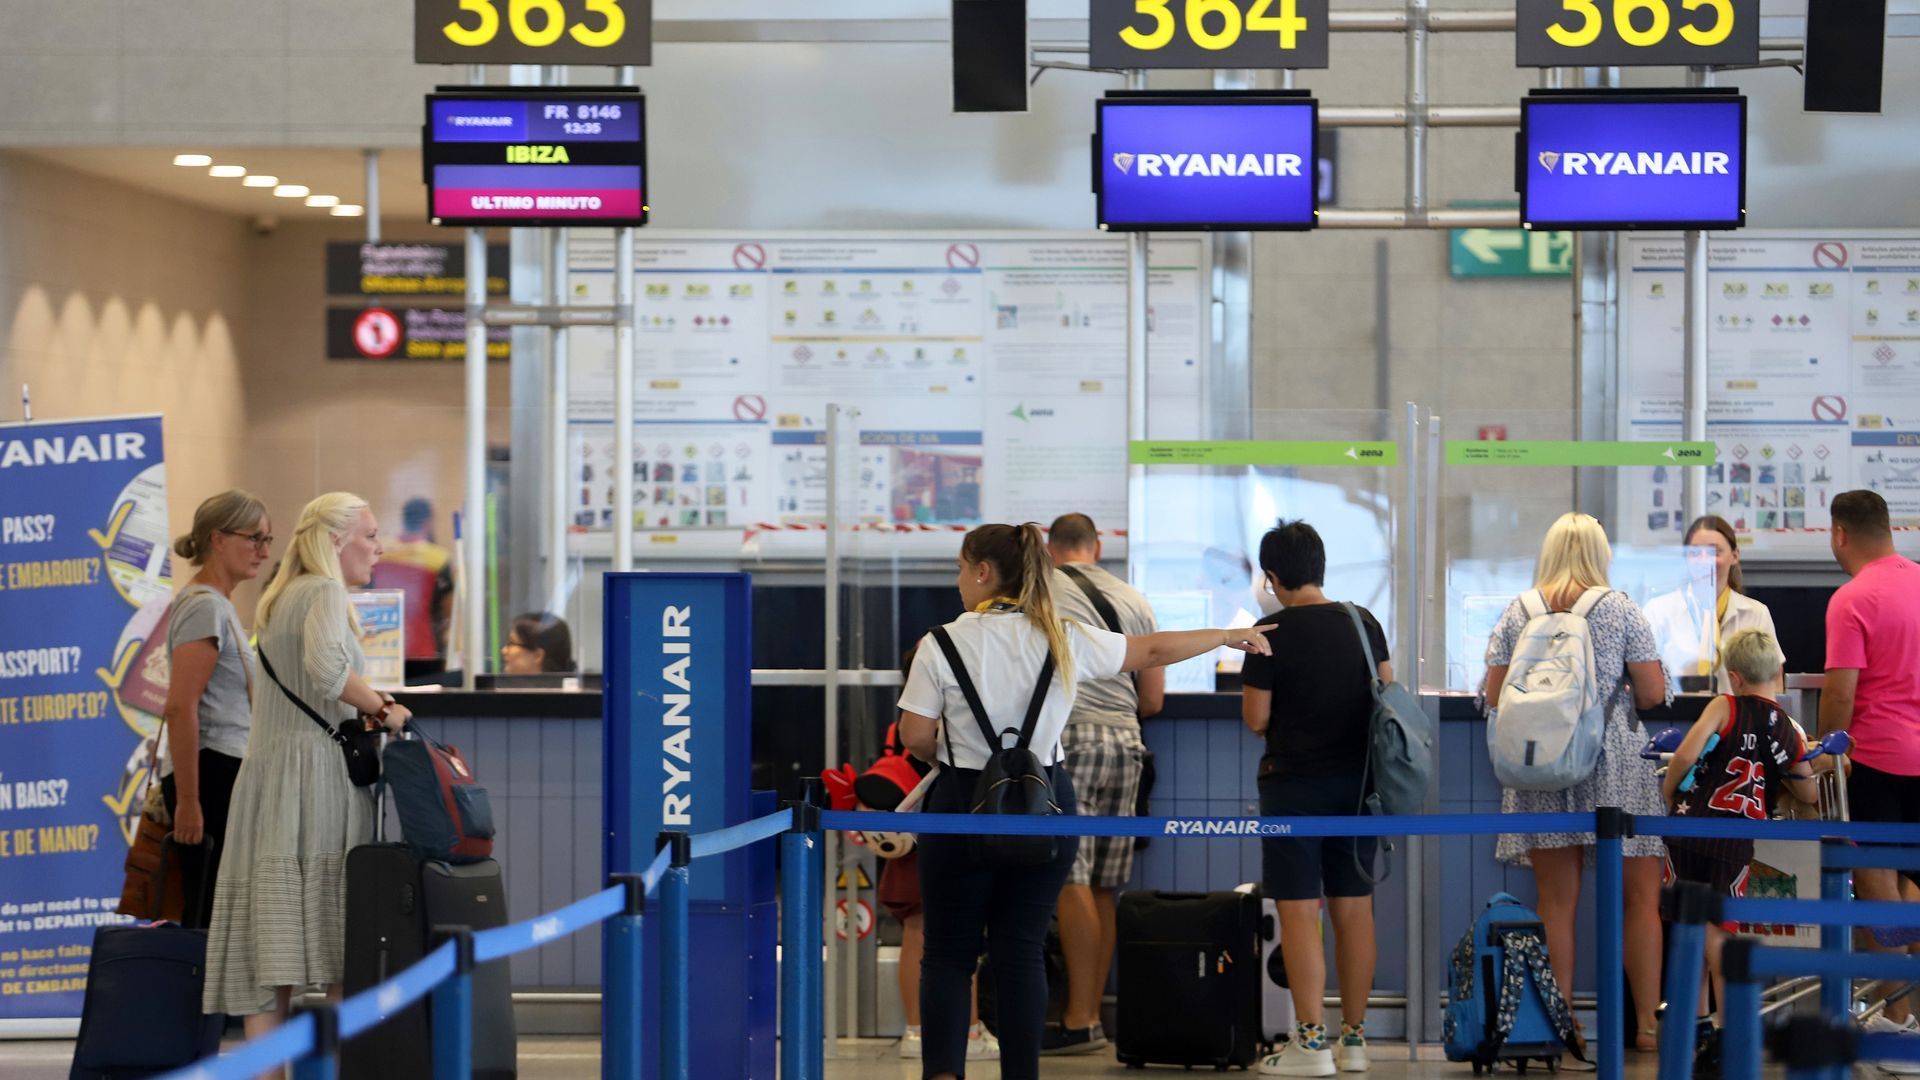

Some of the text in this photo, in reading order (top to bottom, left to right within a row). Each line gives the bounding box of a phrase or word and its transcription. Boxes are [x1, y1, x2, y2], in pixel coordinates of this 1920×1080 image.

[442, 0, 626, 47] 363
[1119, 0, 1307, 50] 364
[1545, 0, 1735, 47] 365
[455, 116, 513, 127] RYANAIR
[544, 105, 622, 120] FR 8146
[563, 122, 602, 134] 13:35
[506, 146, 570, 163] IBIZA
[1137, 154, 1302, 176] RYANAIR
[1563, 152, 1730, 175] RYANAIR
[471, 196, 602, 210] ULTIMO MINUTO
[0, 432, 146, 468] ANAIR
[1677, 448, 1702, 457] aena
[2, 514, 55, 544] PASS?
[8, 557, 101, 590] EMBARQUE?
[23, 691, 108, 723] EUROPEO?
[662, 605, 692, 825] RYANAIR
[16, 778, 69, 809] BAGS?
[1708, 756, 1768, 820] 23
[14, 828, 36, 857] DE
[39, 823, 99, 853] MANO?
[1, 902, 19, 916] do
[21, 901, 45, 914] not
[47, 897, 81, 911] need
[84, 897, 99, 909] to
[16, 920, 32, 931] to
[34, 912, 136, 929] DEPARTURES
[21, 947, 55, 960] hace
[2, 982, 22, 995] DE
